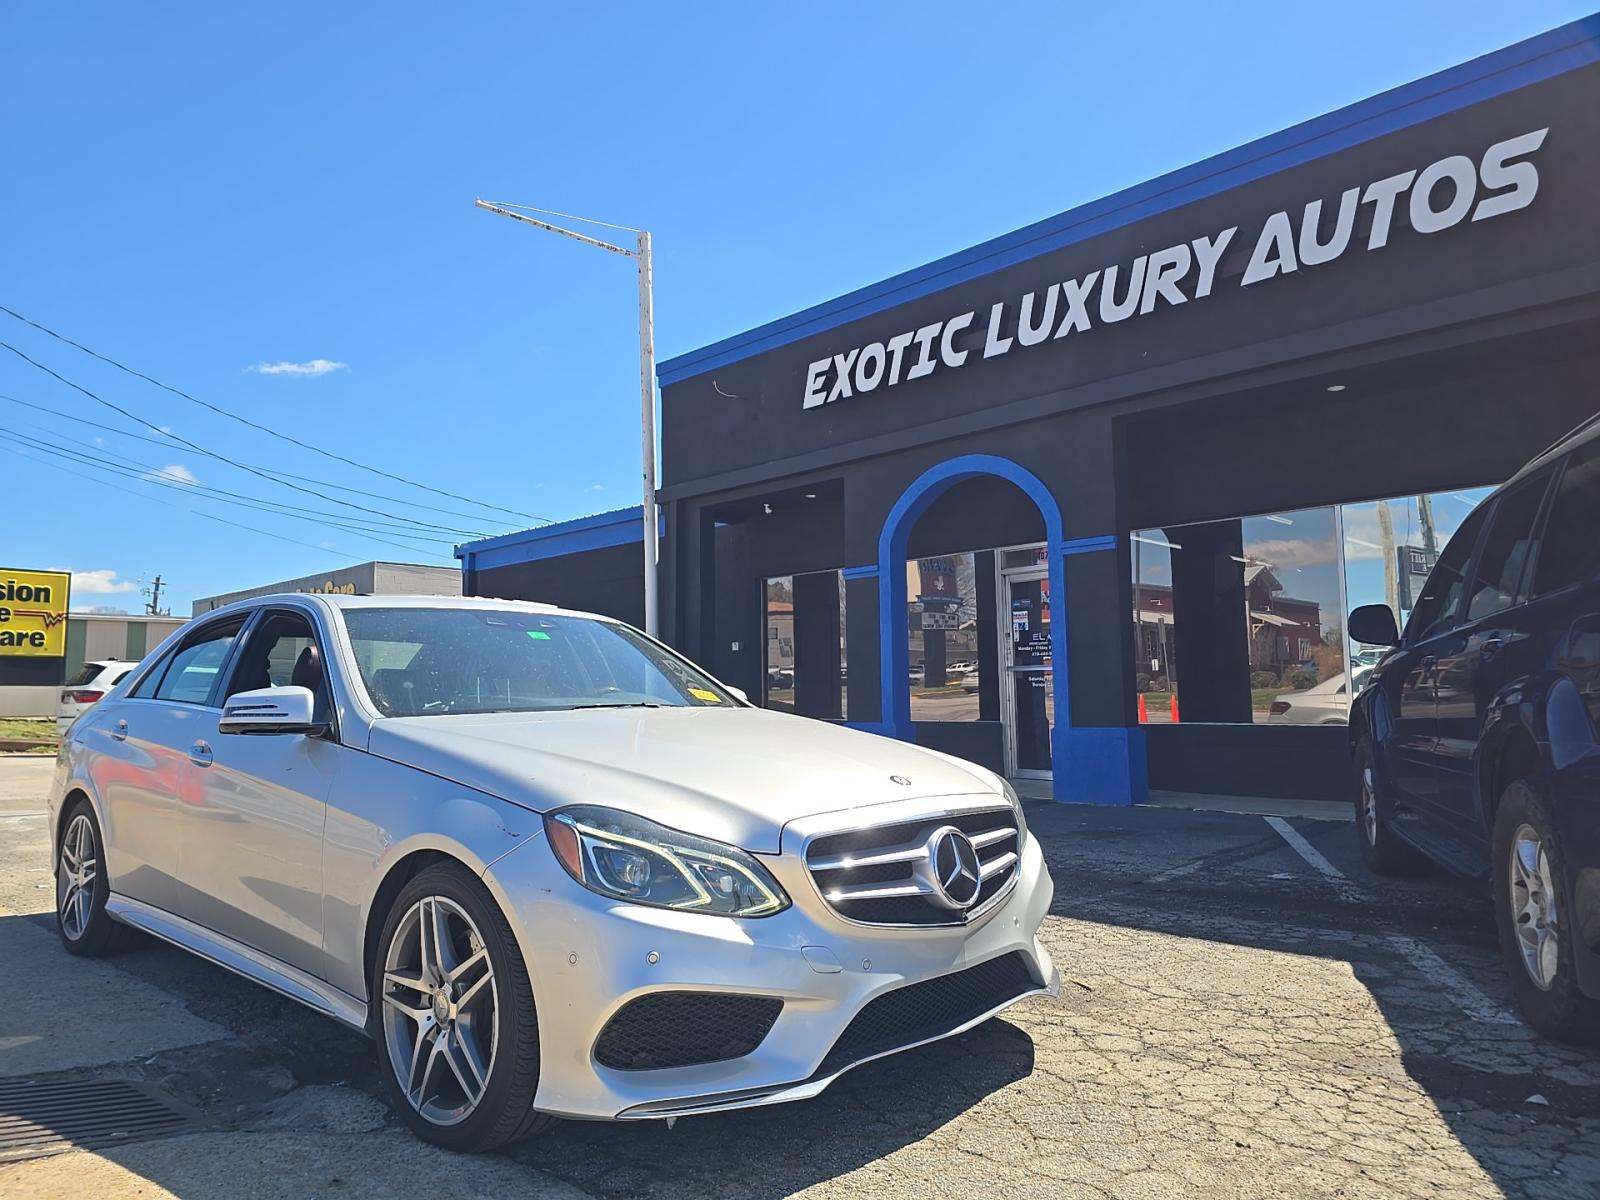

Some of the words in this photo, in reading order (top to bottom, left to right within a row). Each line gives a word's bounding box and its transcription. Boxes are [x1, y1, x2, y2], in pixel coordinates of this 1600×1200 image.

[802, 312, 975, 410] EXOTIC
[983, 226, 1238, 359] LUXURY
[1241, 127, 1550, 287] AUTOS
